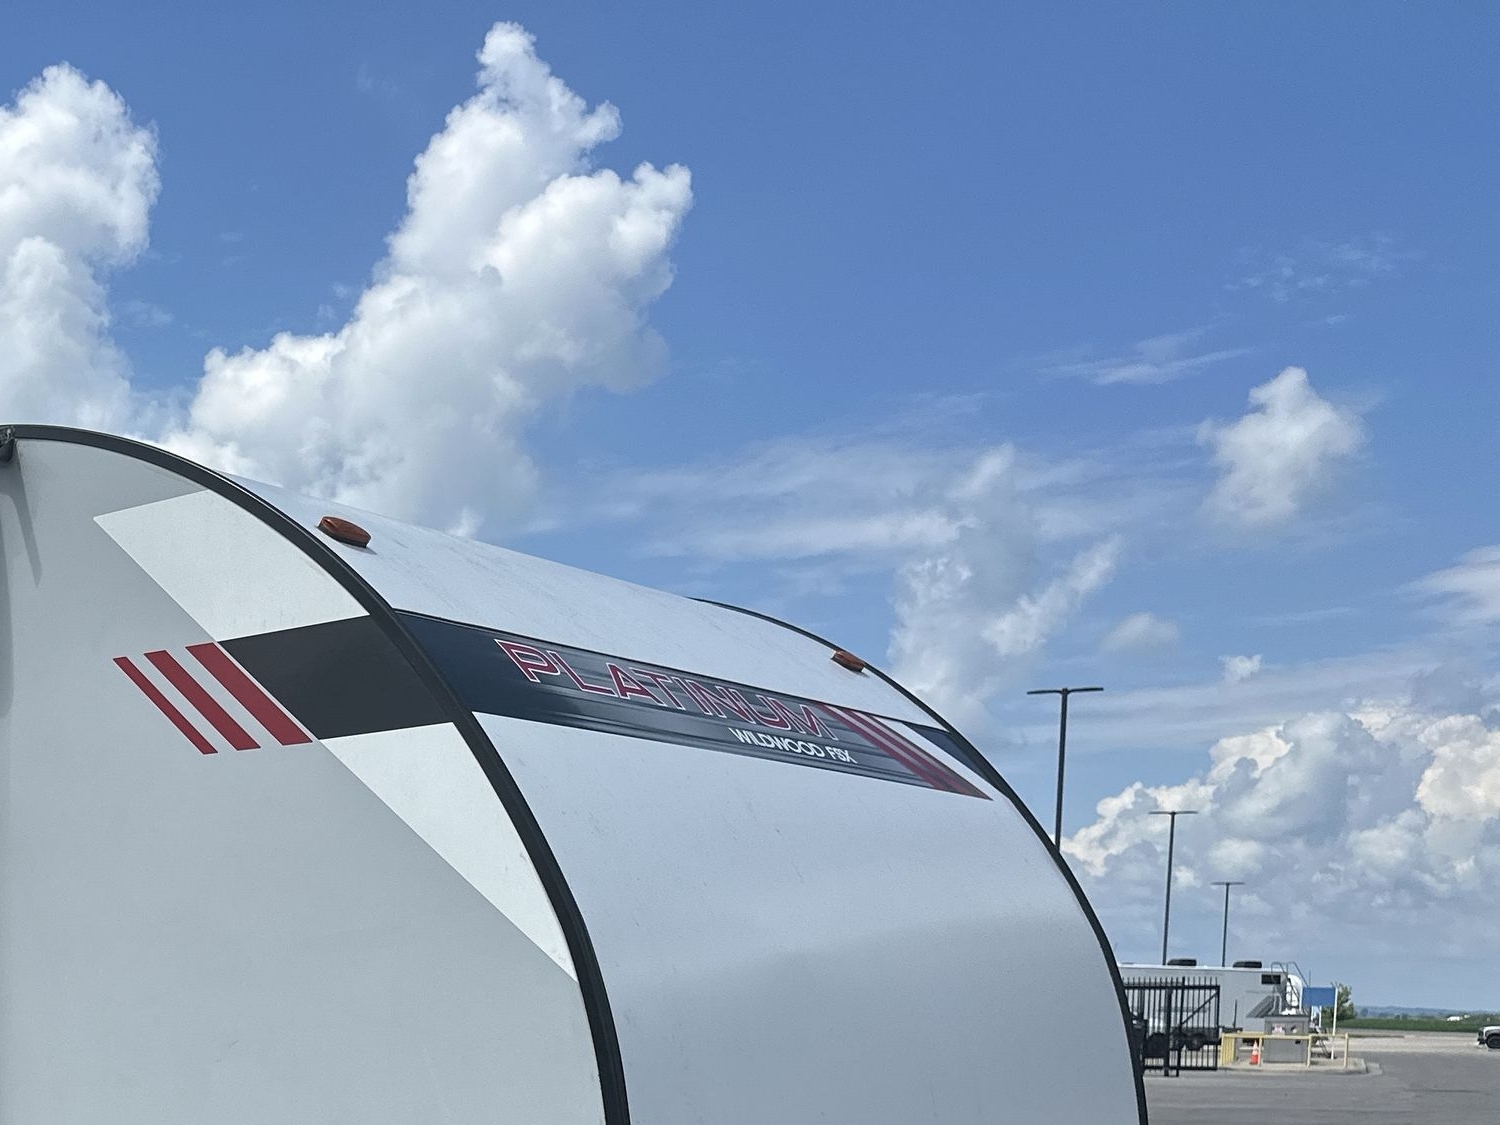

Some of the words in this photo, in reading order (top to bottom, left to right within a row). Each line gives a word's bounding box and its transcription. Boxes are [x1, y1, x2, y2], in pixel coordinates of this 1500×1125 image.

[494, 639, 839, 740] PLATINUM
[729, 728, 825, 758] WILDWOOD
[825, 746, 858, 764] FSX
